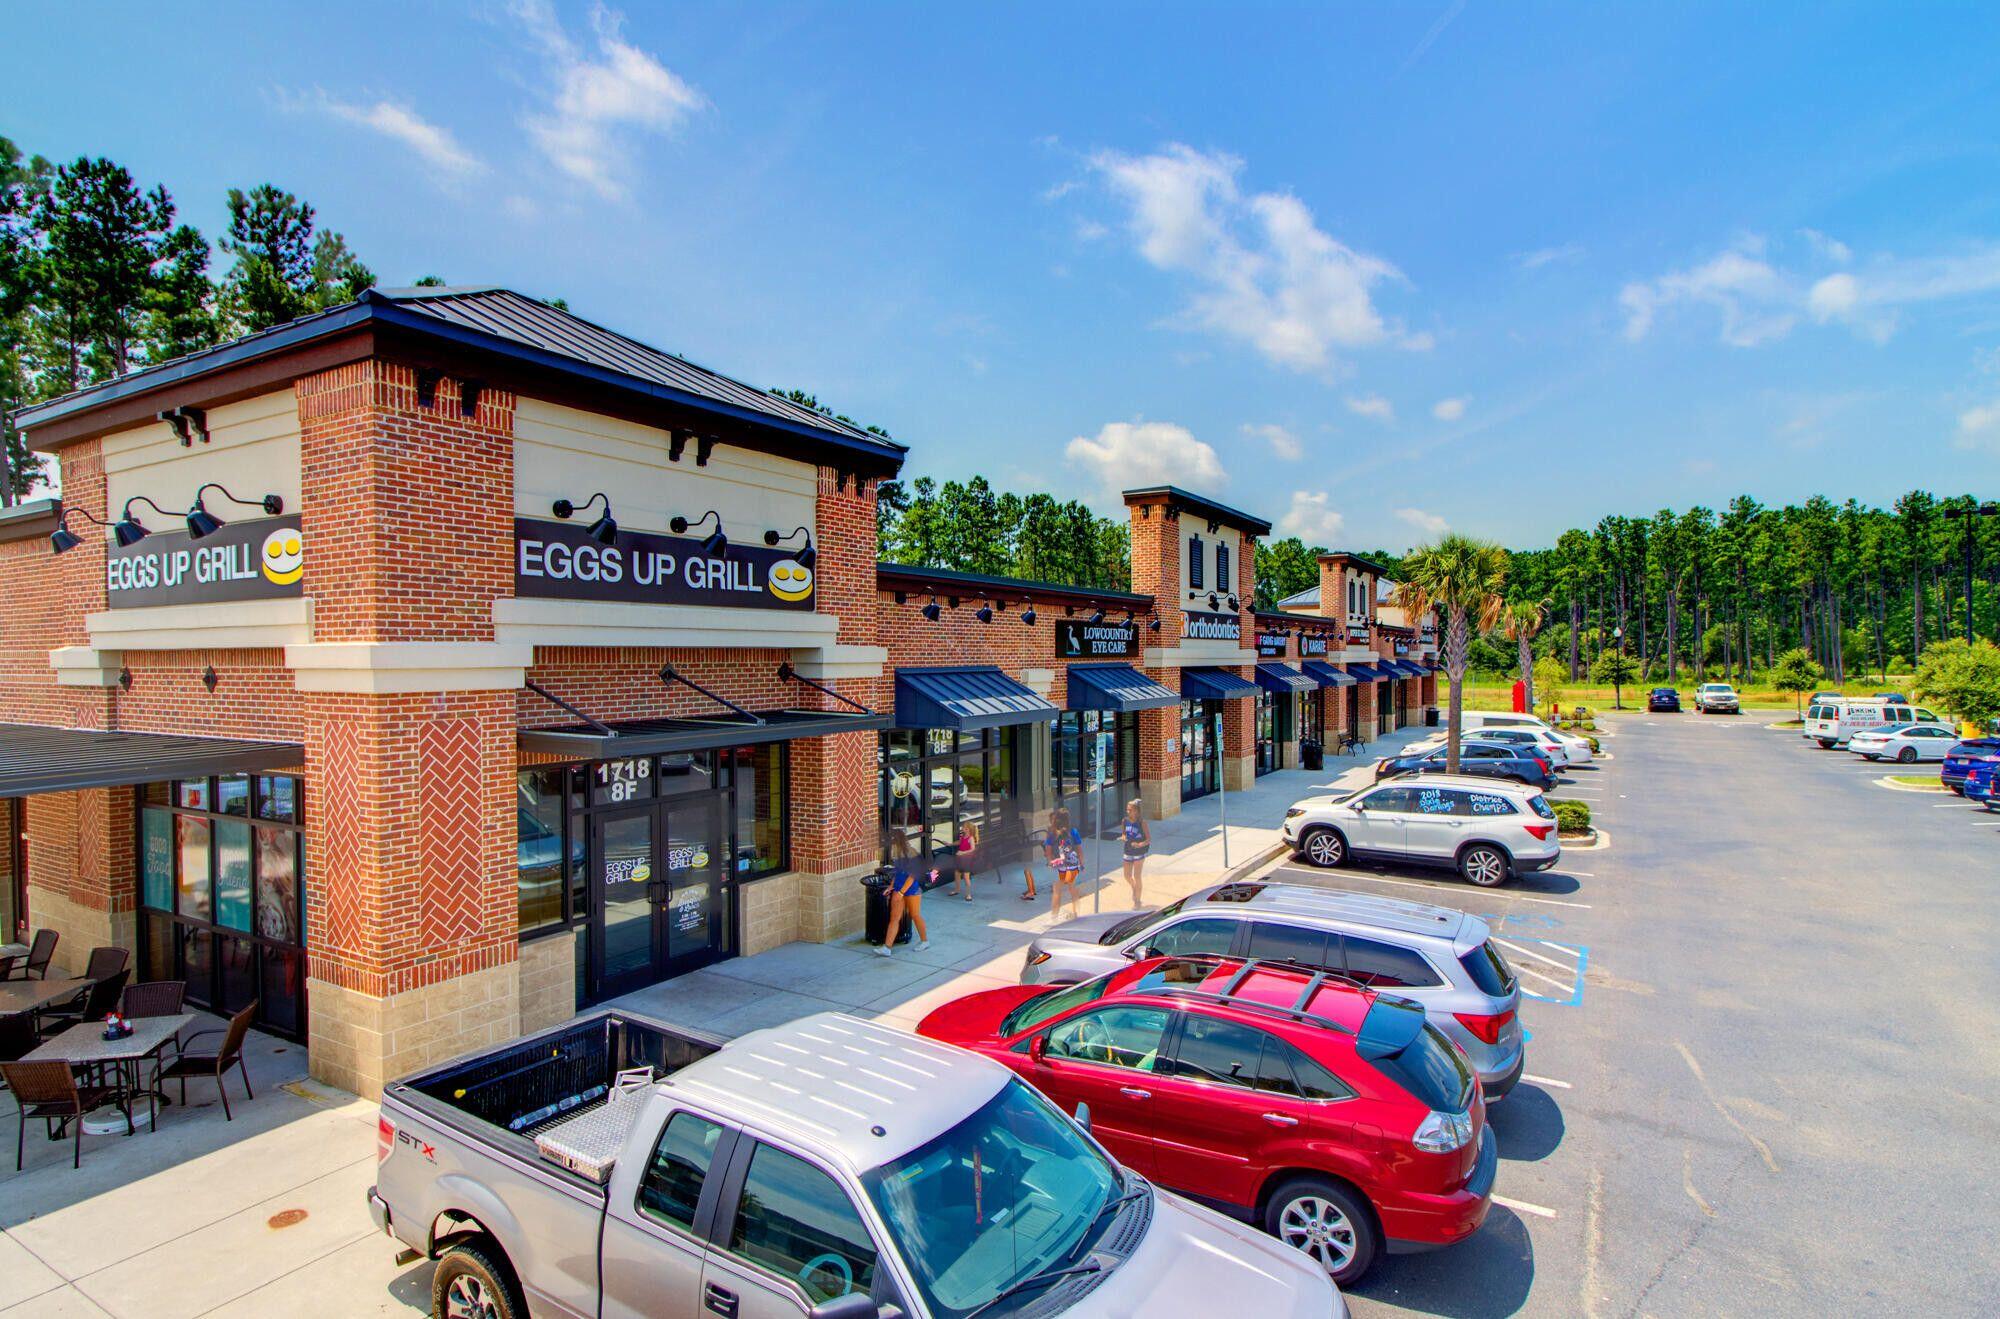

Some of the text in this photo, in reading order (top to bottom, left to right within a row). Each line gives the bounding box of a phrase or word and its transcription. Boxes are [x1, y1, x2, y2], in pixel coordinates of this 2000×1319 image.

[107, 543, 258, 590] EGGS UP GRILL
[519, 539, 763, 593] EGGS UP GRILL
[1083, 626, 1134, 640] LOWCOUNTRY
[1190, 617, 1240, 639] orthodontics
[1092, 641, 1127, 653] EYE CARE
[927, 728, 953, 742] 1718
[933, 741, 948, 754] 8E
[598, 759, 650, 783] 1718
[611, 780, 638, 802] 8F
[669, 847, 693, 860] EGGS
[606, 857, 645, 874] EGGS UP
[669, 858, 692, 870] GRILL
[606, 870, 632, 885] GRILL
[398, 1130, 436, 1158] STX
